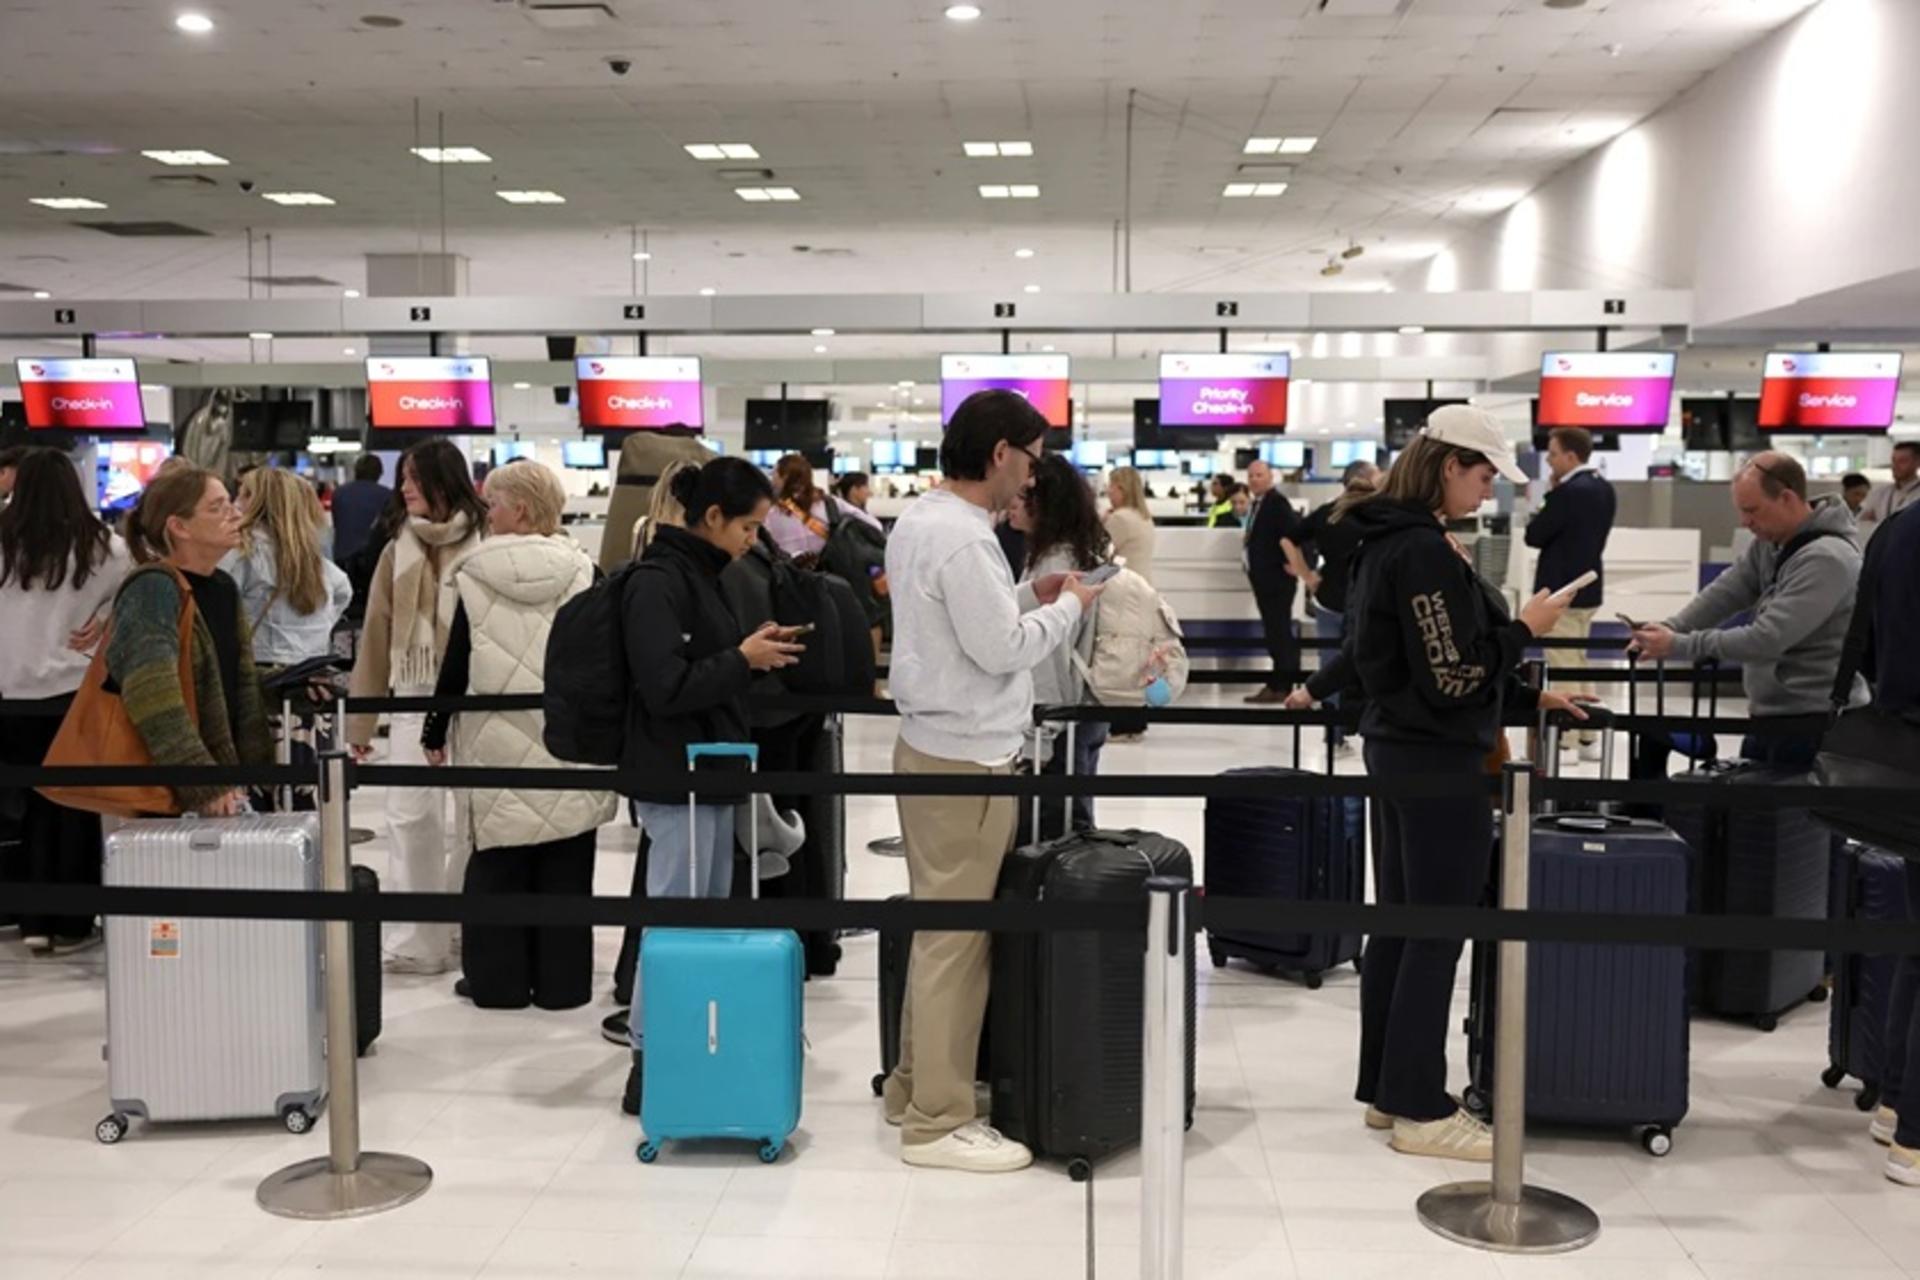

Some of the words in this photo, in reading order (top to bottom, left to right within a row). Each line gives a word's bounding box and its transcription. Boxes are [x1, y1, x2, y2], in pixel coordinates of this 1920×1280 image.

[1200, 387, 1249, 403] Priority
[1576, 392, 1634, 407] Service
[1799, 392, 1857, 407] Service
